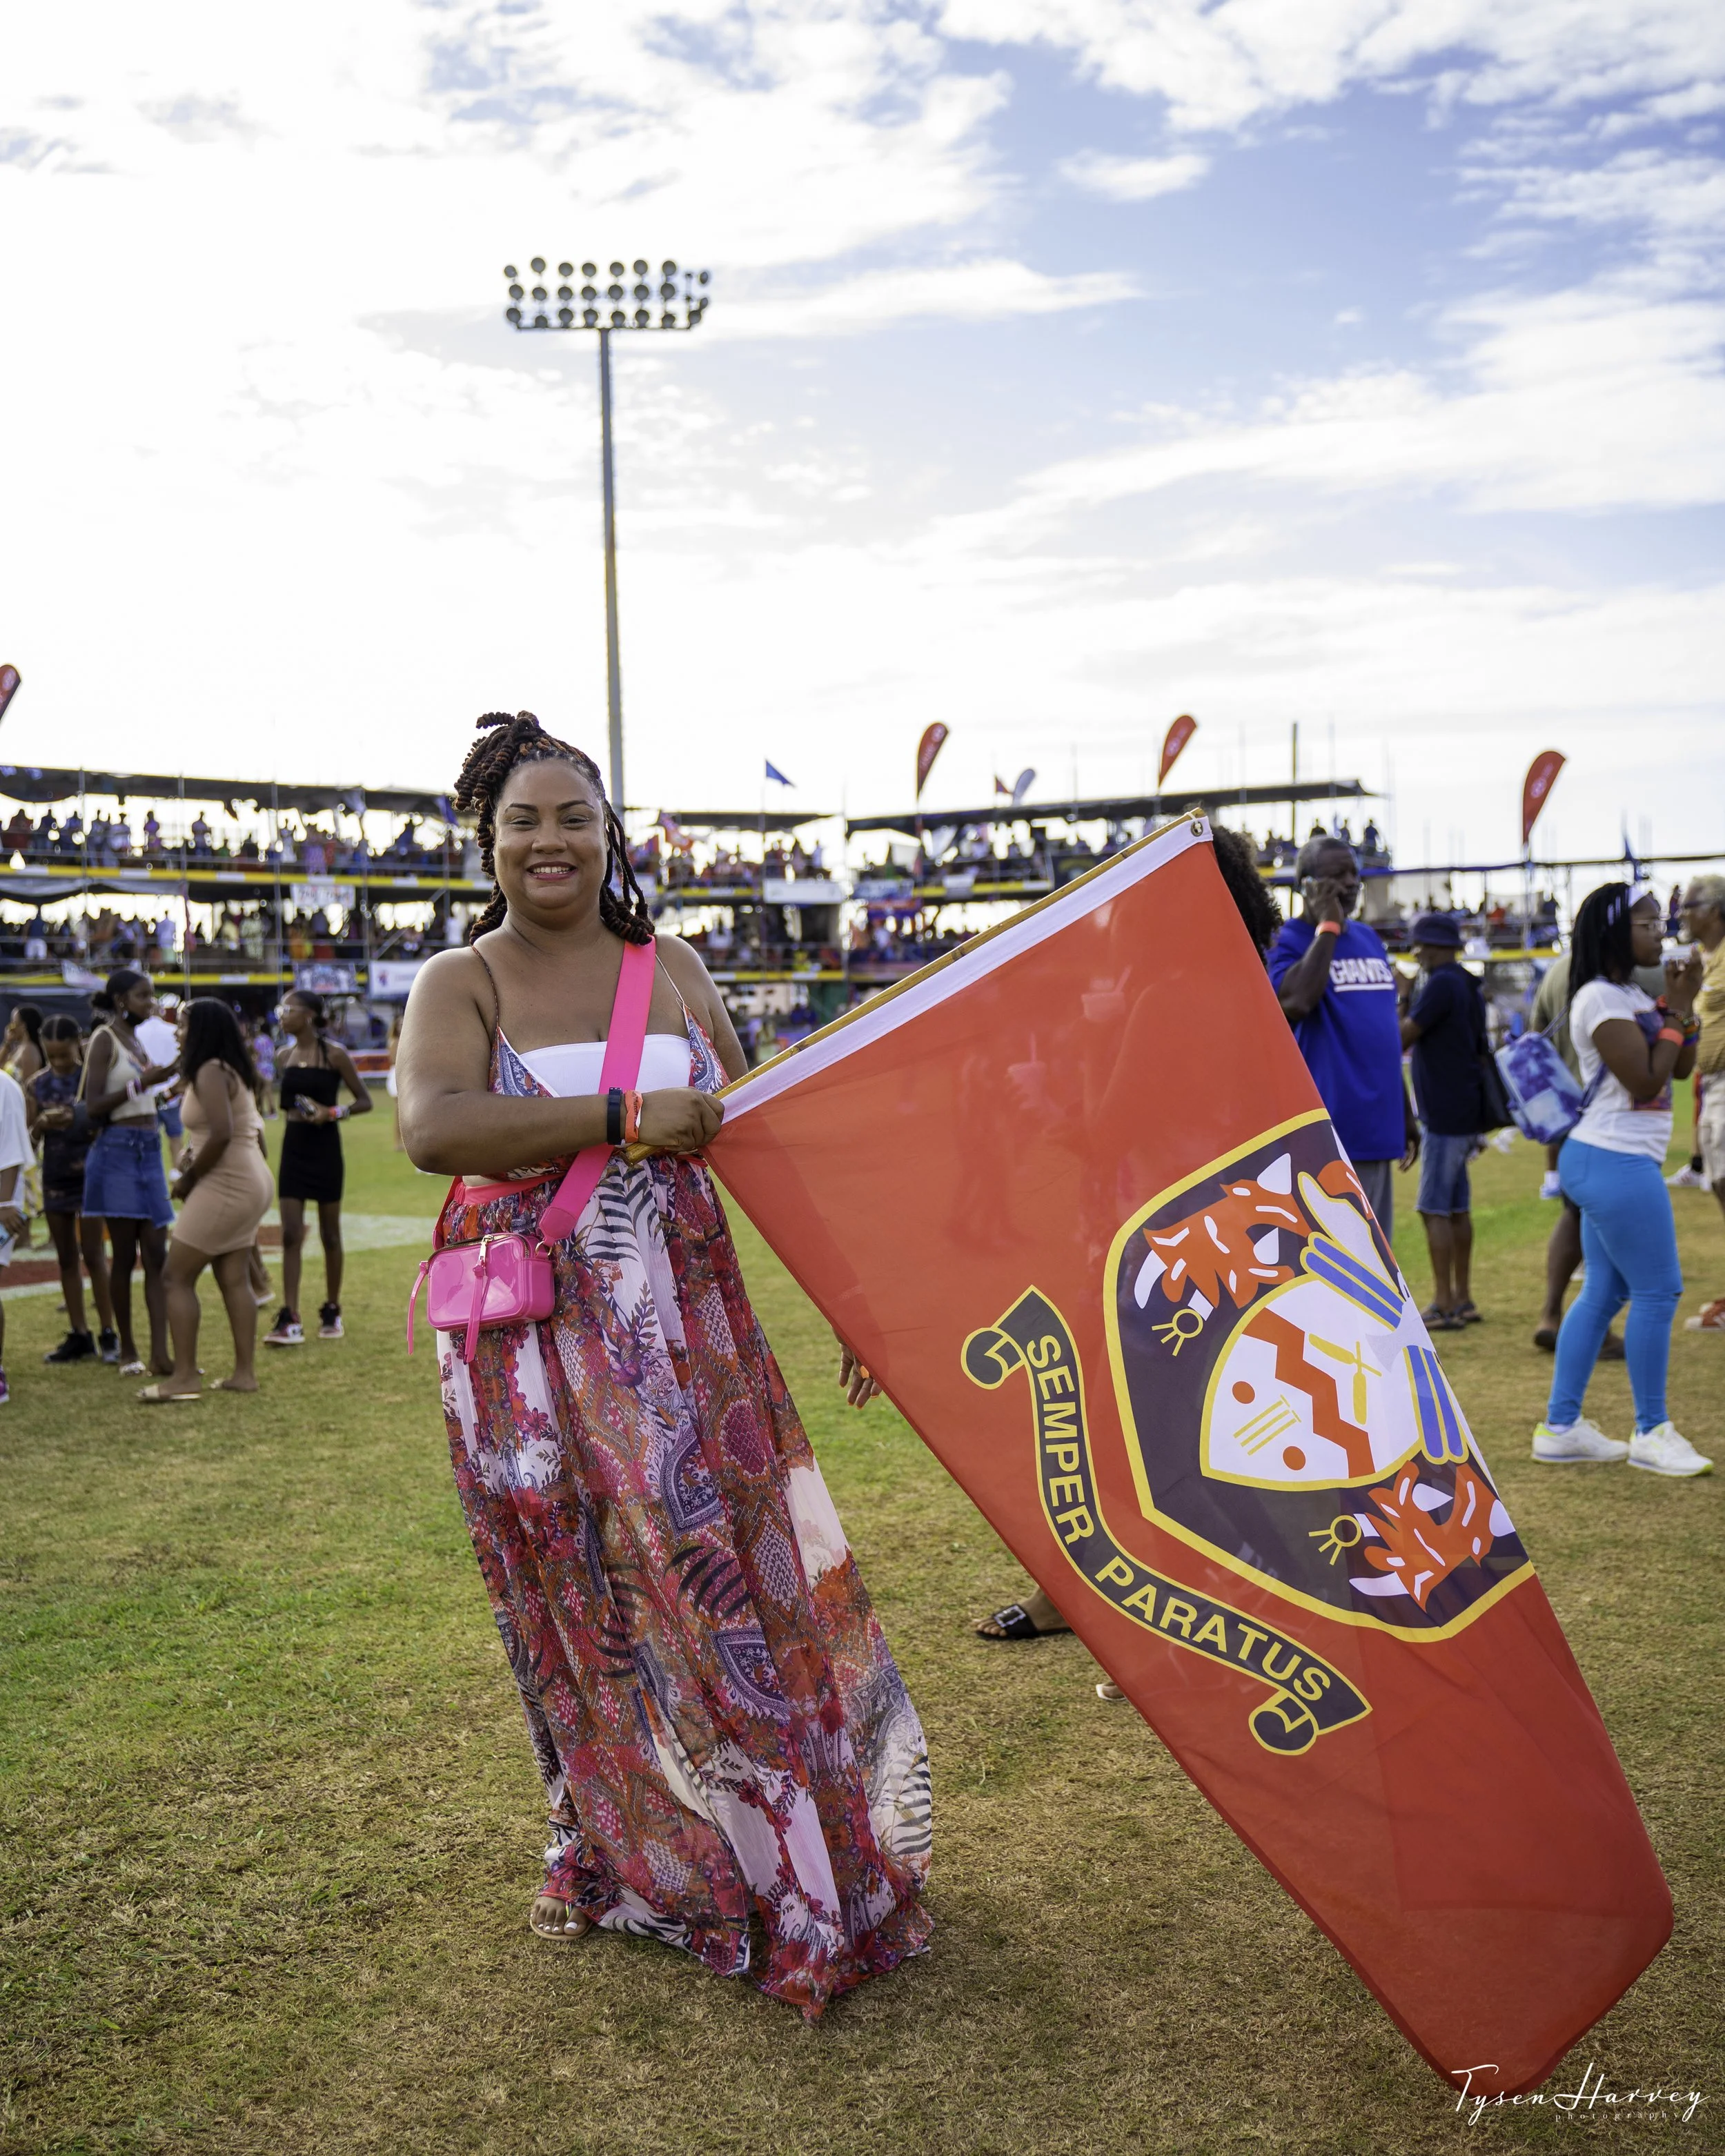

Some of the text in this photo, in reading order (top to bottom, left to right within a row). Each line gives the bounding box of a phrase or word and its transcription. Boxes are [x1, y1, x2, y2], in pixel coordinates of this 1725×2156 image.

[1329, 958, 1393, 985] GIANTS
[1026, 1334, 1331, 1702] SEMPER PARATUS
